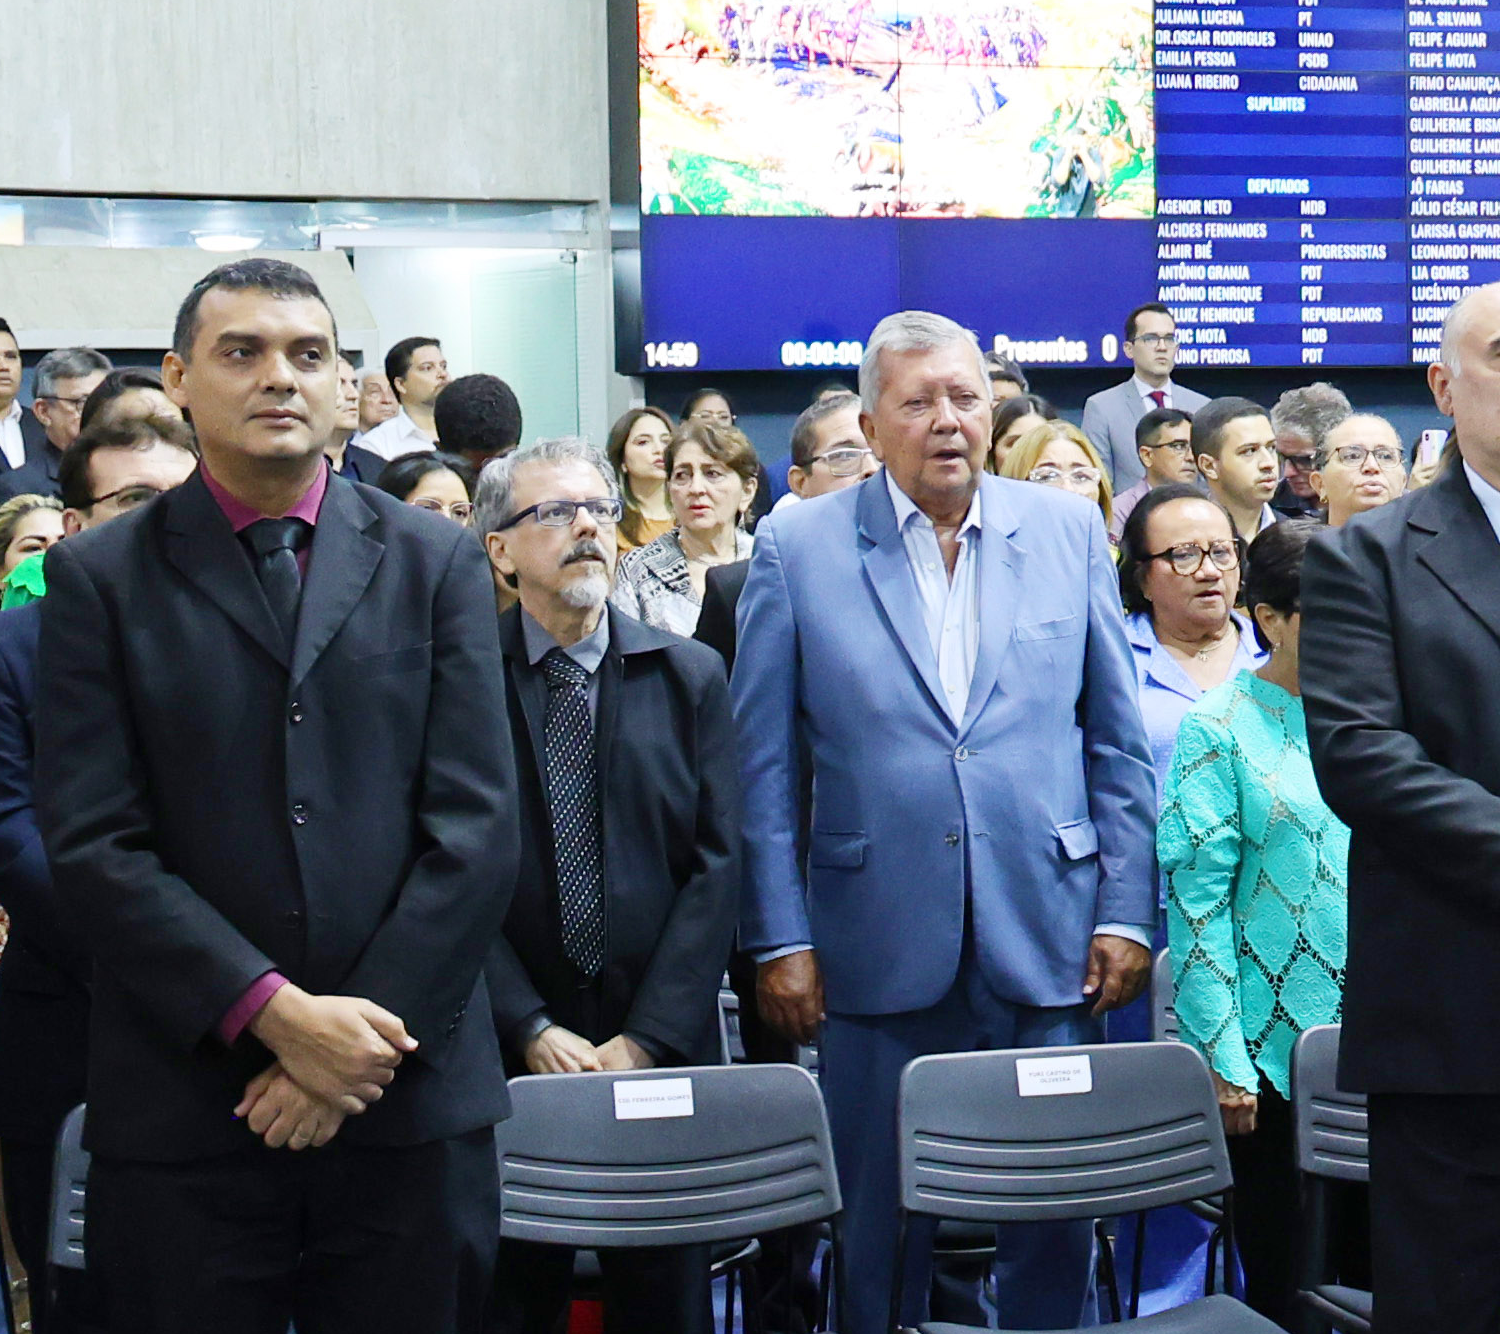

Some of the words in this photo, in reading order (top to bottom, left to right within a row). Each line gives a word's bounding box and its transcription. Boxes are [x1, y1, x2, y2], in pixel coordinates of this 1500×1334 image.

[1155, 10, 1199, 25] JULIANA
[1201, 10, 1244, 25] LUCENA
[1298, 12, 1313, 27] PT
[1409, 11, 1434, 26] DRA.
[1436, 12, 1482, 27] SILVANA
[1213, 31, 1276, 47] RODRIGUES
[1298, 33, 1334, 47] UNIAO
[1409, 33, 1444, 47] FELIPE
[1446, 33, 1487, 48] AGUIAR
[1156, 51, 1192, 66] EMILIA
[1194, 52, 1236, 67] PESSOA
[1299, 53, 1328, 68] PSDB
[1409, 53, 1444, 68] FELIPE
[1446, 54, 1476, 69] MOTA
[1156, 74, 1192, 89] LUANA
[1194, 74, 1239, 89] RIBEIRO
[1299, 76, 1358, 91] CIDADANIA
[1409, 76, 1444, 90] FIRMO
[1446, 76, 1500, 94] CAMURÇA
[1246, 97, 1305, 111] SUPLENTES
[1409, 97, 1468, 112] GABRIELLA
[1410, 118, 1472, 133] GUILHERME
[1410, 139, 1472, 154] GUILHERME
[1410, 160, 1472, 174] GUILHERME
[1247, 179, 1310, 194] DEPUTADOS
[1426, 180, 1464, 195] FARIAS
[1157, 201, 1201, 215] AGENOR
[1204, 201, 1232, 215] NETO
[1300, 201, 1326, 215] MDB
[1411, 198, 1441, 216] JÚLIO
[1443, 198, 1478, 216] CÉSAR
[1158, 223, 1203, 238] ALCIDES
[1205, 223, 1267, 238] FERNANDES
[1300, 224, 1315, 238] PL
[1411, 224, 1457, 238] LARISSA
[1458, 224, 1500, 238] GASPAR
[1158, 244, 1192, 259] ALMIR
[1195, 240, 1213, 259] BIÉ
[1301, 245, 1386, 260] PROGRESSISTAS
[1412, 245, 1469, 260] LEONARDO
[1158, 262, 1206, 280] ANTÔNIO
[1208, 265, 1250, 280] GRANJA
[1301, 266, 1322, 280] PDT
[1412, 265, 1429, 280] LIA
[1431, 265, 1469, 280] GOMES
[1158, 283, 1206, 301] ANTÔNIO
[1208, 286, 1262, 302] HENRIQUE
[1301, 286, 1322, 302] PDT
[1412, 283, 1461, 301] LUCÍLVIO
[1165, 307, 1197, 322] LUIZ
[1200, 307, 1255, 324] HENRIQUE
[1301, 307, 1383, 322] REPUBLICANOS
[1196, 329, 1226, 343] MOTA
[1302, 329, 1327, 343] MDB
[644, 341, 698, 367] 14:59
[781, 341, 863, 365] 00:00:00
[994, 335, 1087, 364] Presentes
[1200, 349, 1250, 364] PEDROSA
[1302, 349, 1323, 364] PDT
